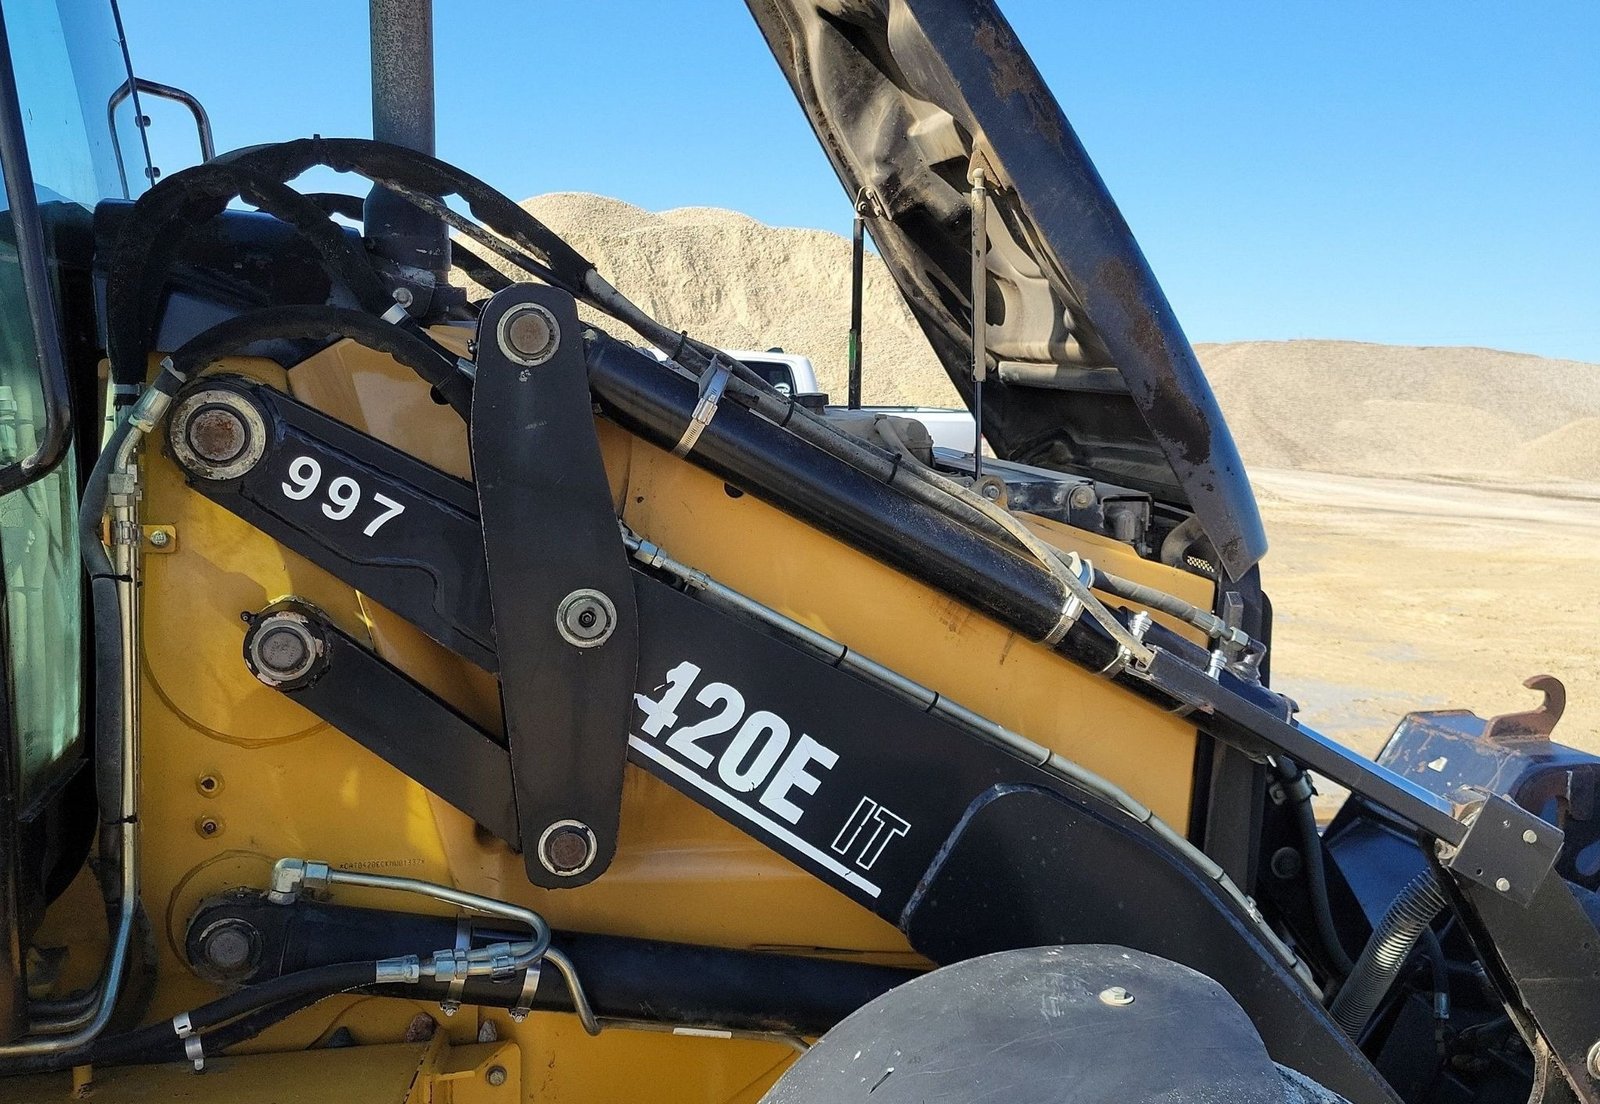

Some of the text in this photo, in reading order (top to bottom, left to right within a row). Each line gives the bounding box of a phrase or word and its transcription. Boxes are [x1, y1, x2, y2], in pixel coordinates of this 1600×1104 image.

[281, 456, 405, 537] 997
[634, 661, 911, 870] 420E IT
